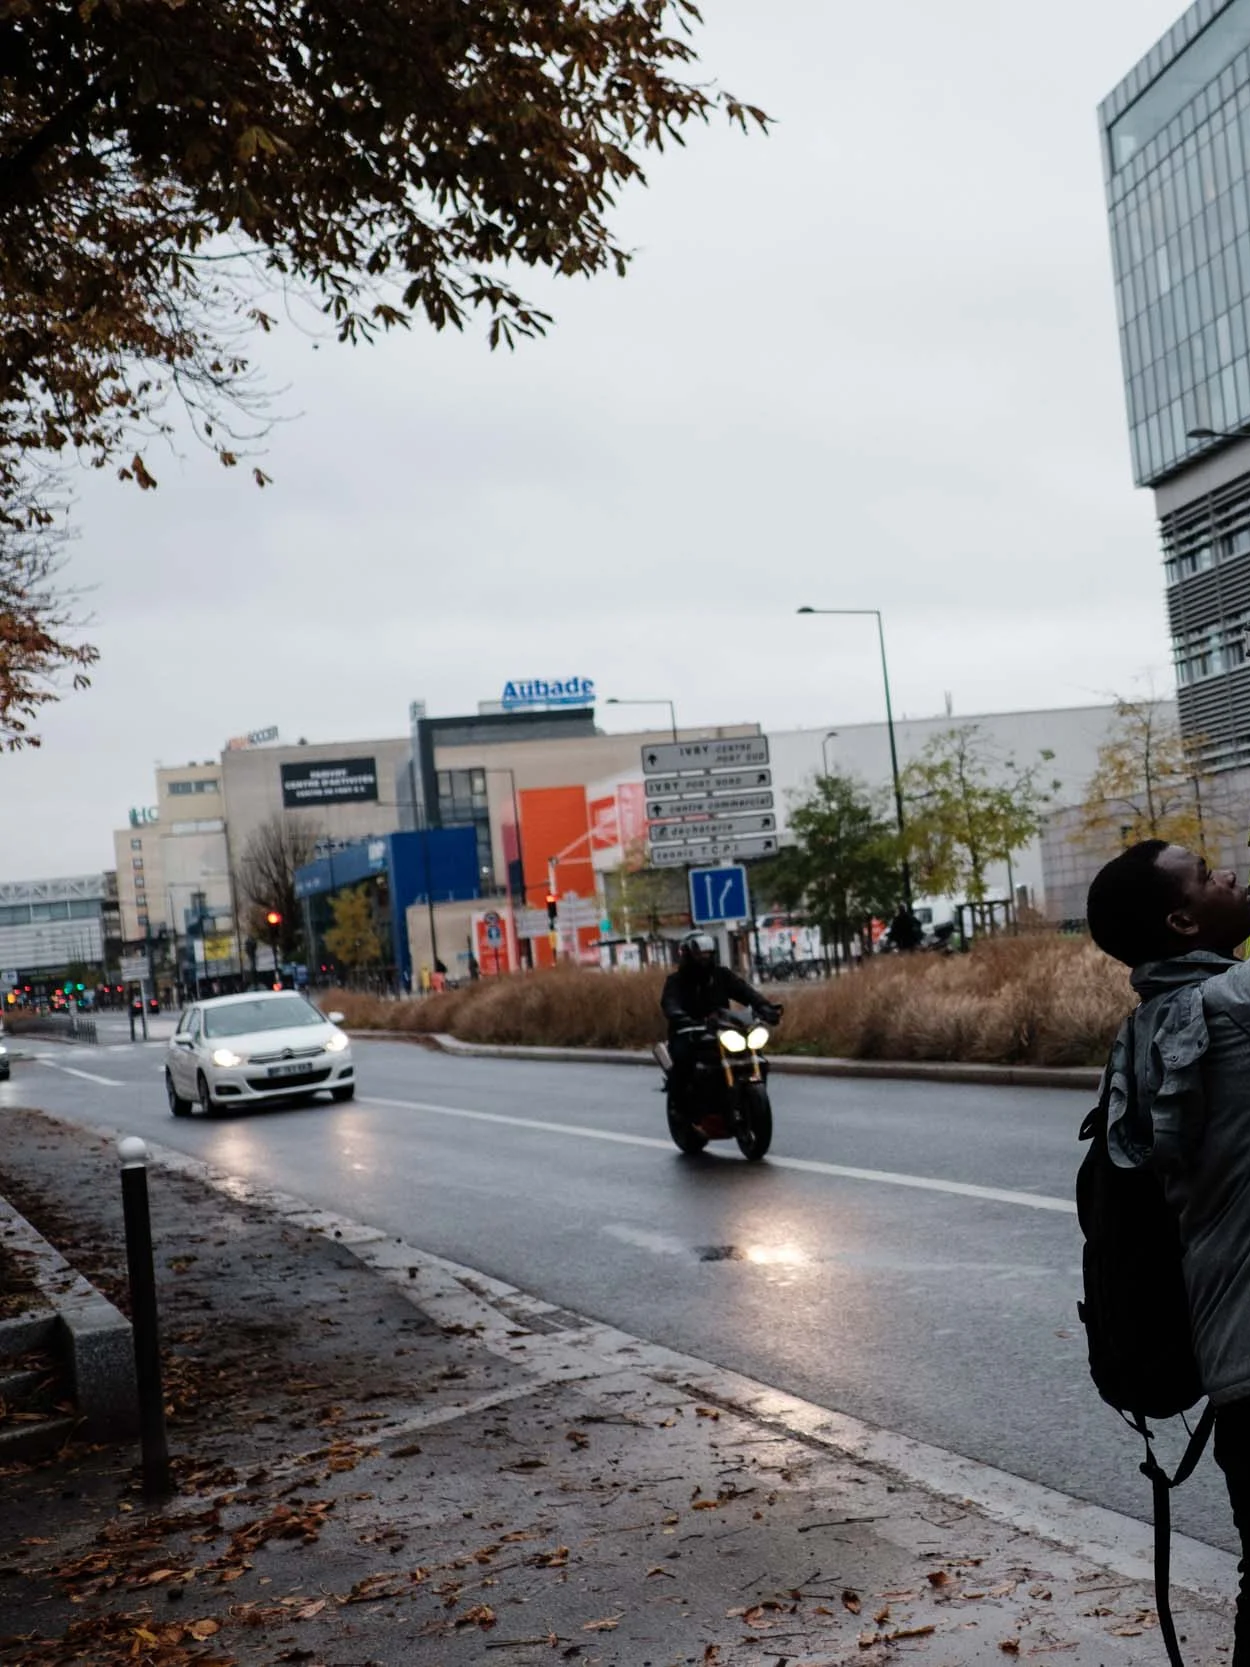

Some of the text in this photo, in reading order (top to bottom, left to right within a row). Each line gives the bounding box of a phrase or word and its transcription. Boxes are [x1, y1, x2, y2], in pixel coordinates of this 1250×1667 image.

[503, 676, 594, 699] Aubade
[679, 744, 709, 756] IVRY
[649, 782, 679, 792] IVRY
